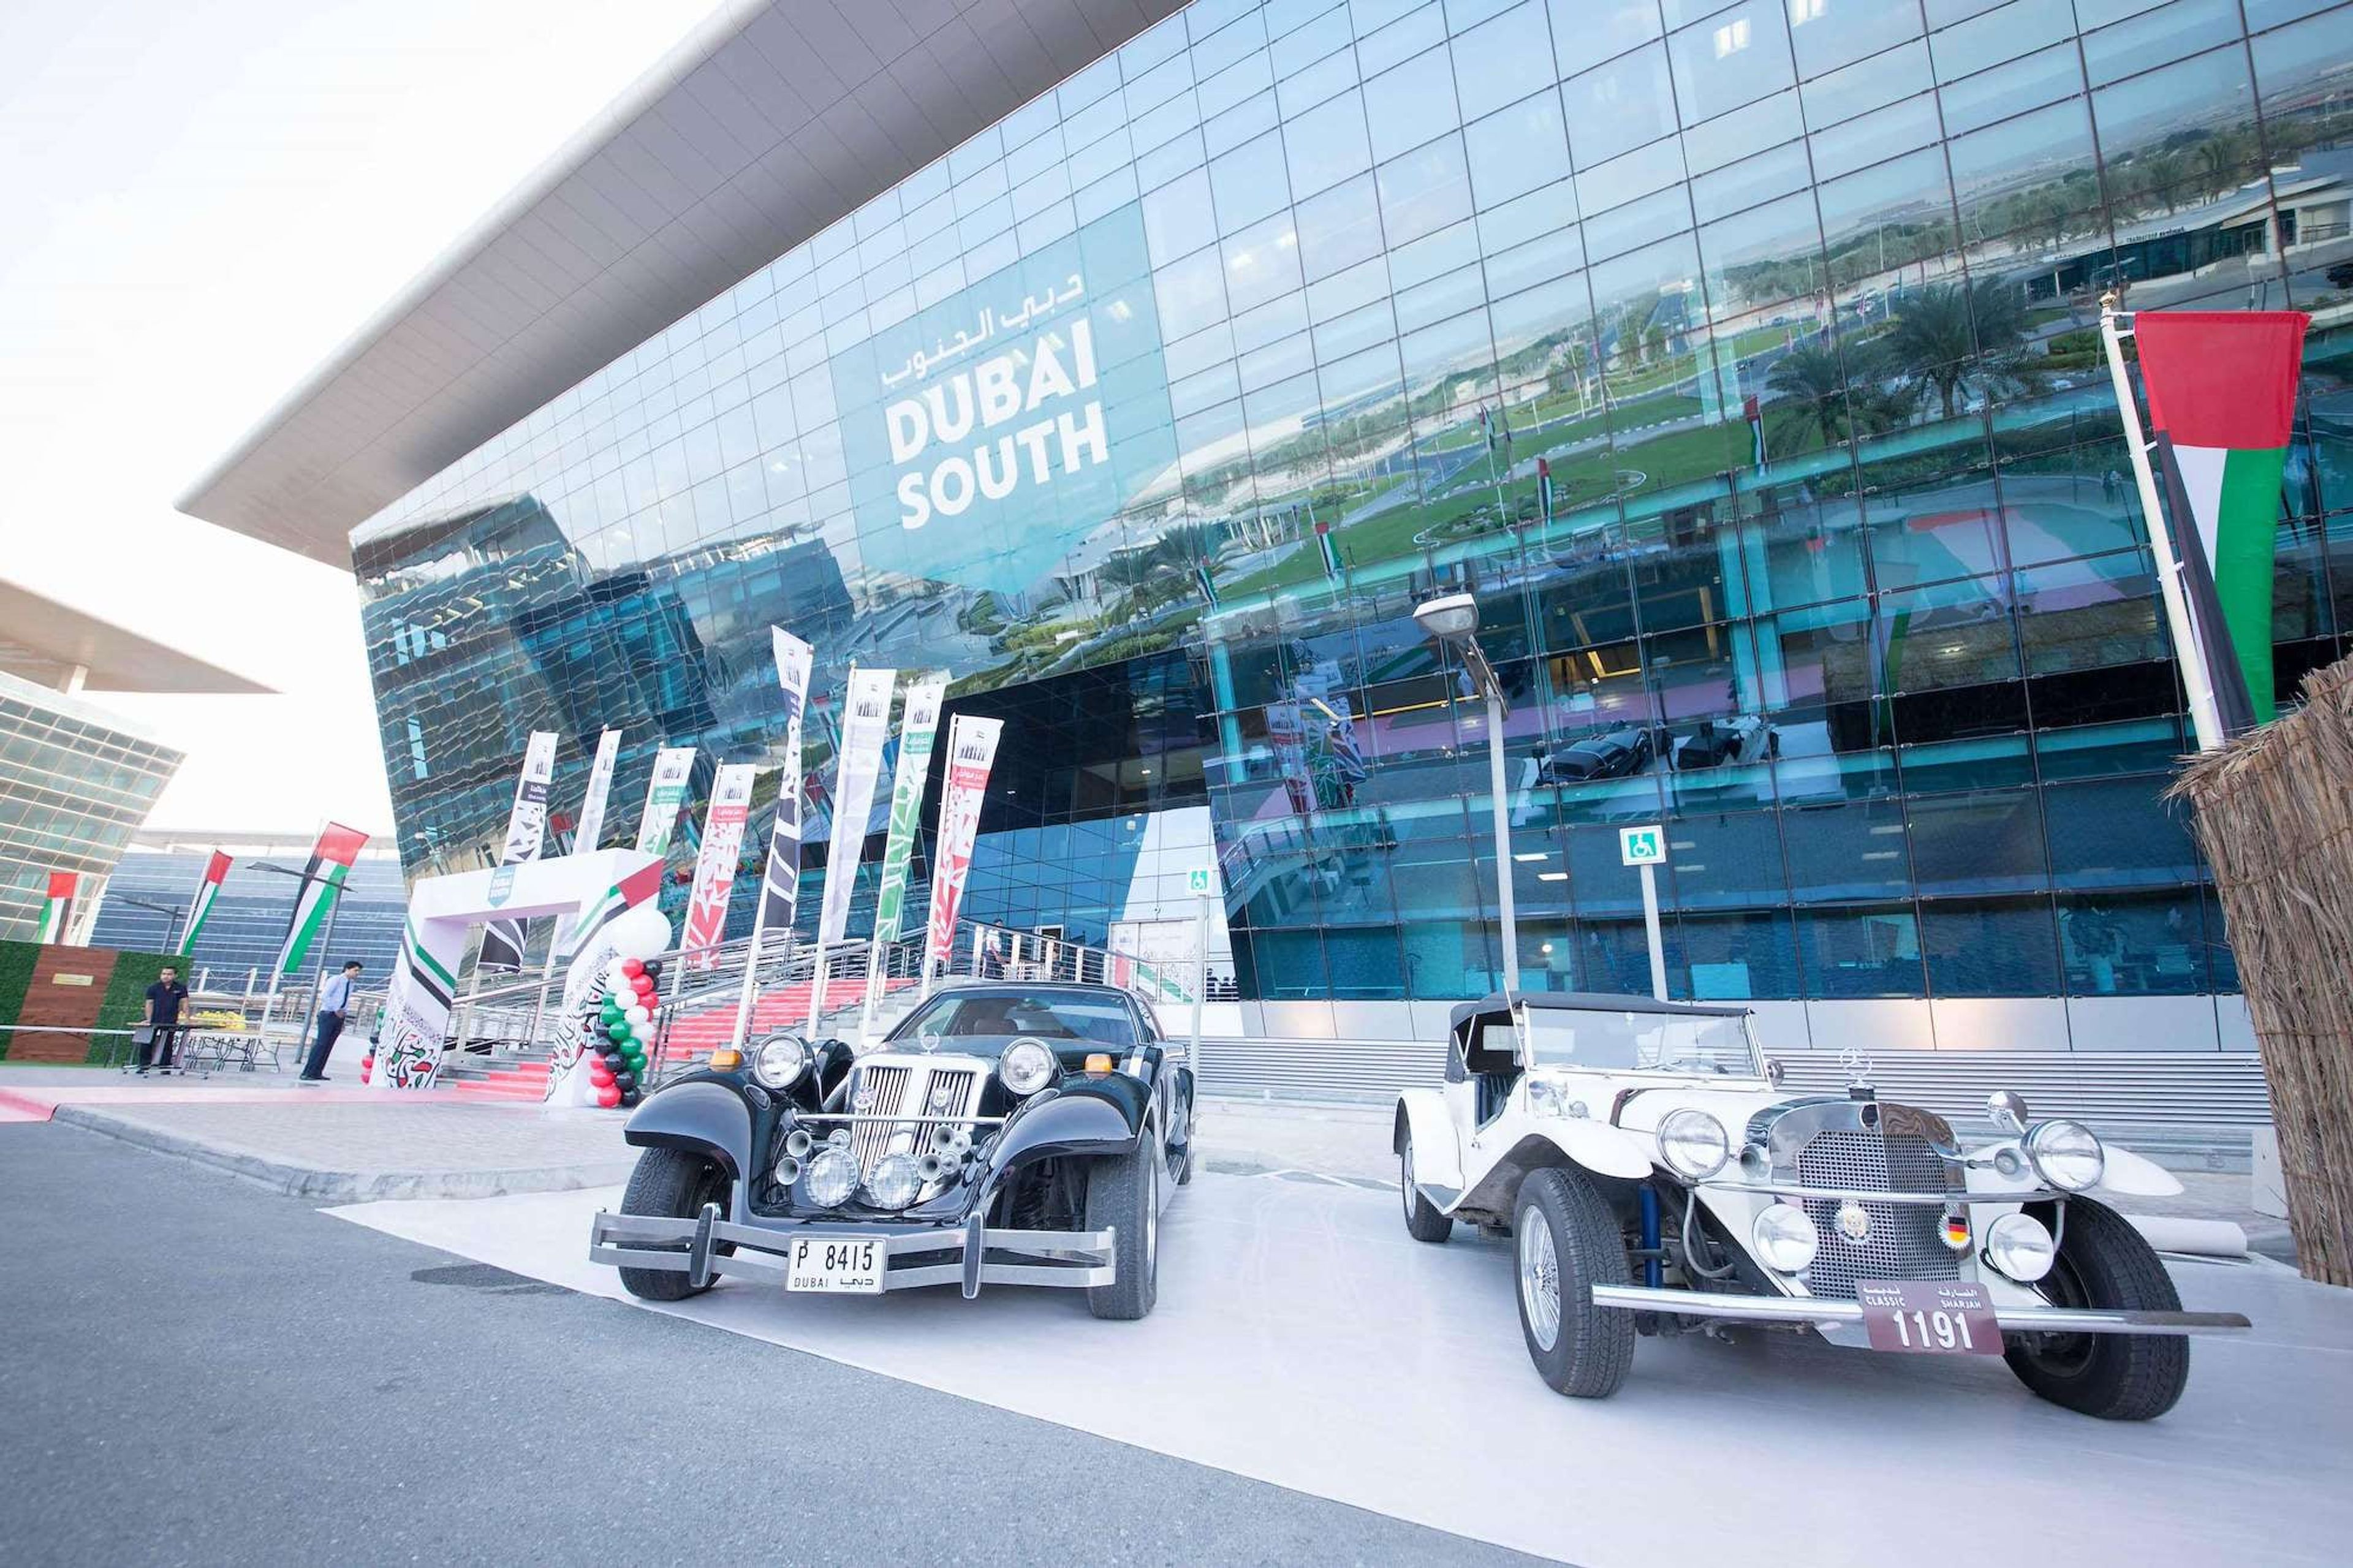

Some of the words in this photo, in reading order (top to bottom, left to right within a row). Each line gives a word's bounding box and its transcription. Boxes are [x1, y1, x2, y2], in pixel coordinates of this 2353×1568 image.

[1001, 274, 1084, 327] دبي
[882, 308, 994, 388] الجنوب
[885, 318, 1097, 465] DUBAI
[898, 401, 1108, 530] SOUTH
[797, 1244, 808, 1268] P
[825, 1244, 873, 1270] 8415
[794, 1278, 828, 1287] DUBAI
[1865, 1295, 1906, 1307] CLASSIC
[1941, 1299, 1982, 1309] SHARJAH
[1893, 1309, 1972, 1349] 1191
